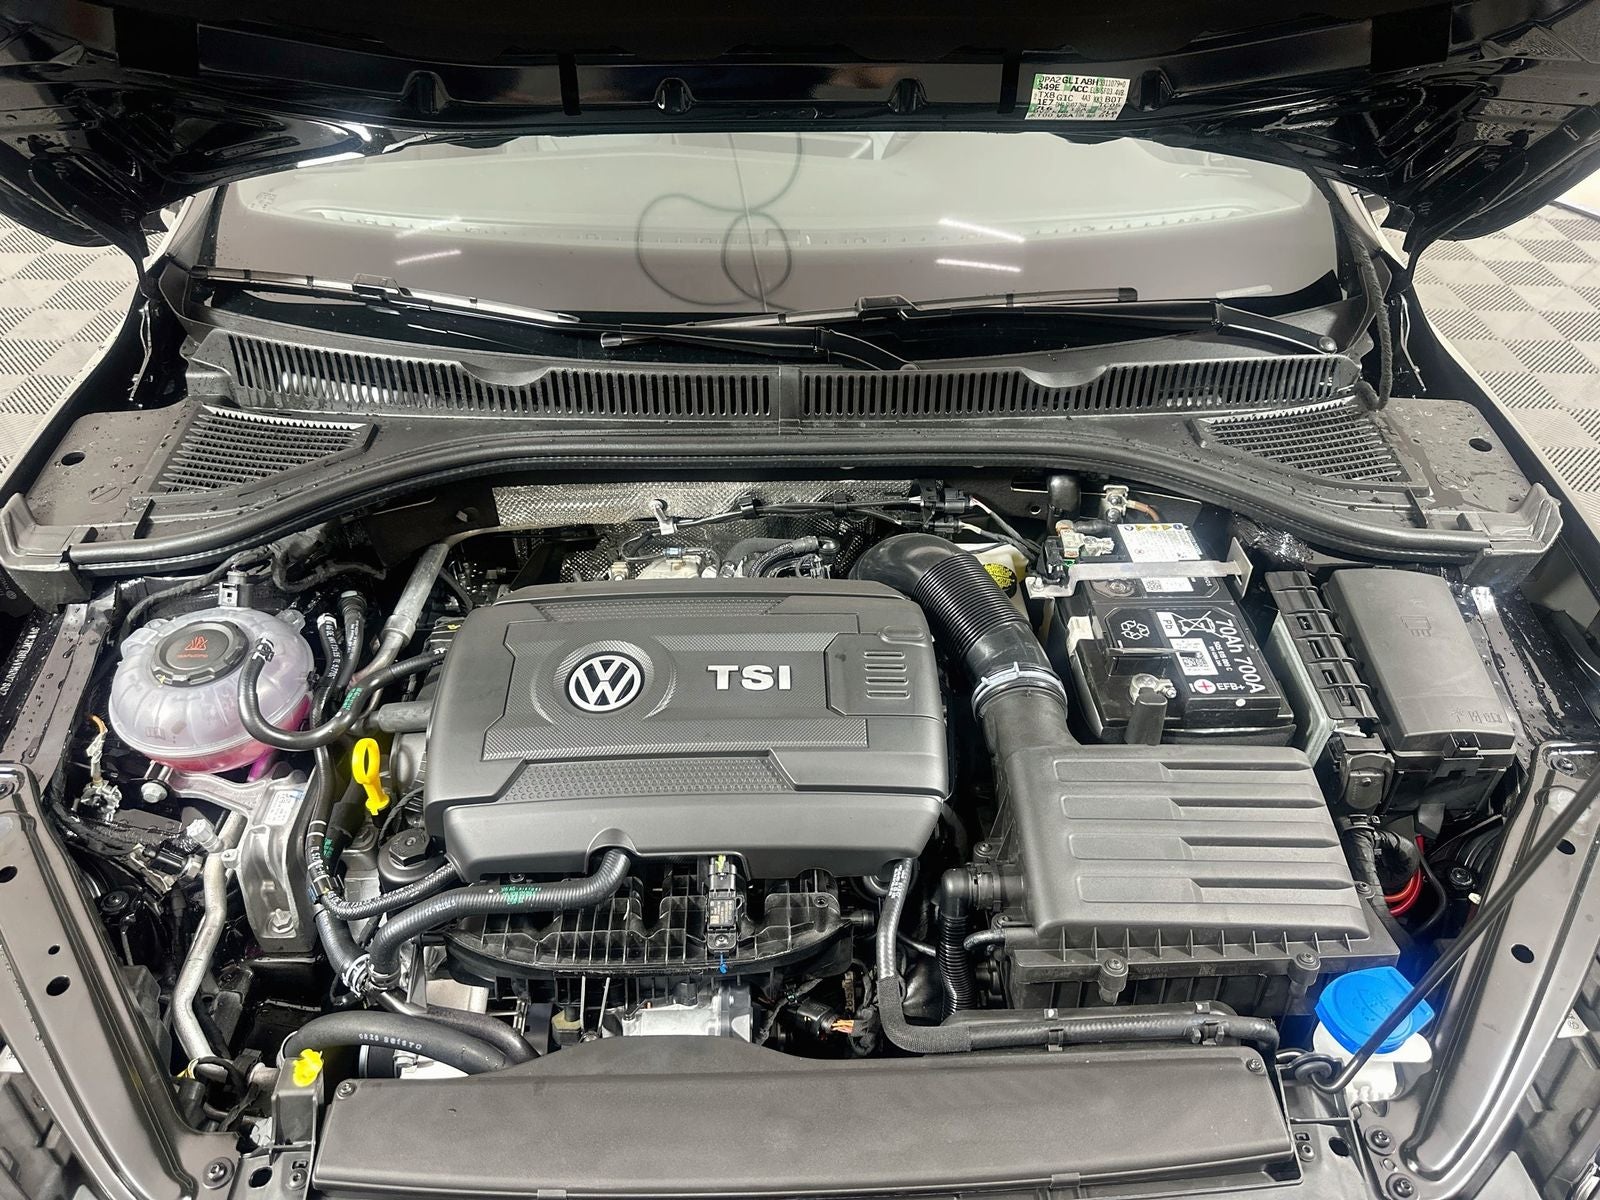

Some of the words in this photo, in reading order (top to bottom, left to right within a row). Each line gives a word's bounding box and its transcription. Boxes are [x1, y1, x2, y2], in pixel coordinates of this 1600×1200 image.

[1070, 85, 1089, 93] ACC
[1216, 619, 1246, 653] 70Ah
[1234, 656, 1266, 694] 700A
[569, 655, 641, 711] VW
[707, 664, 791, 691] TSI
[1216, 682, 1246, 692] EFB+
